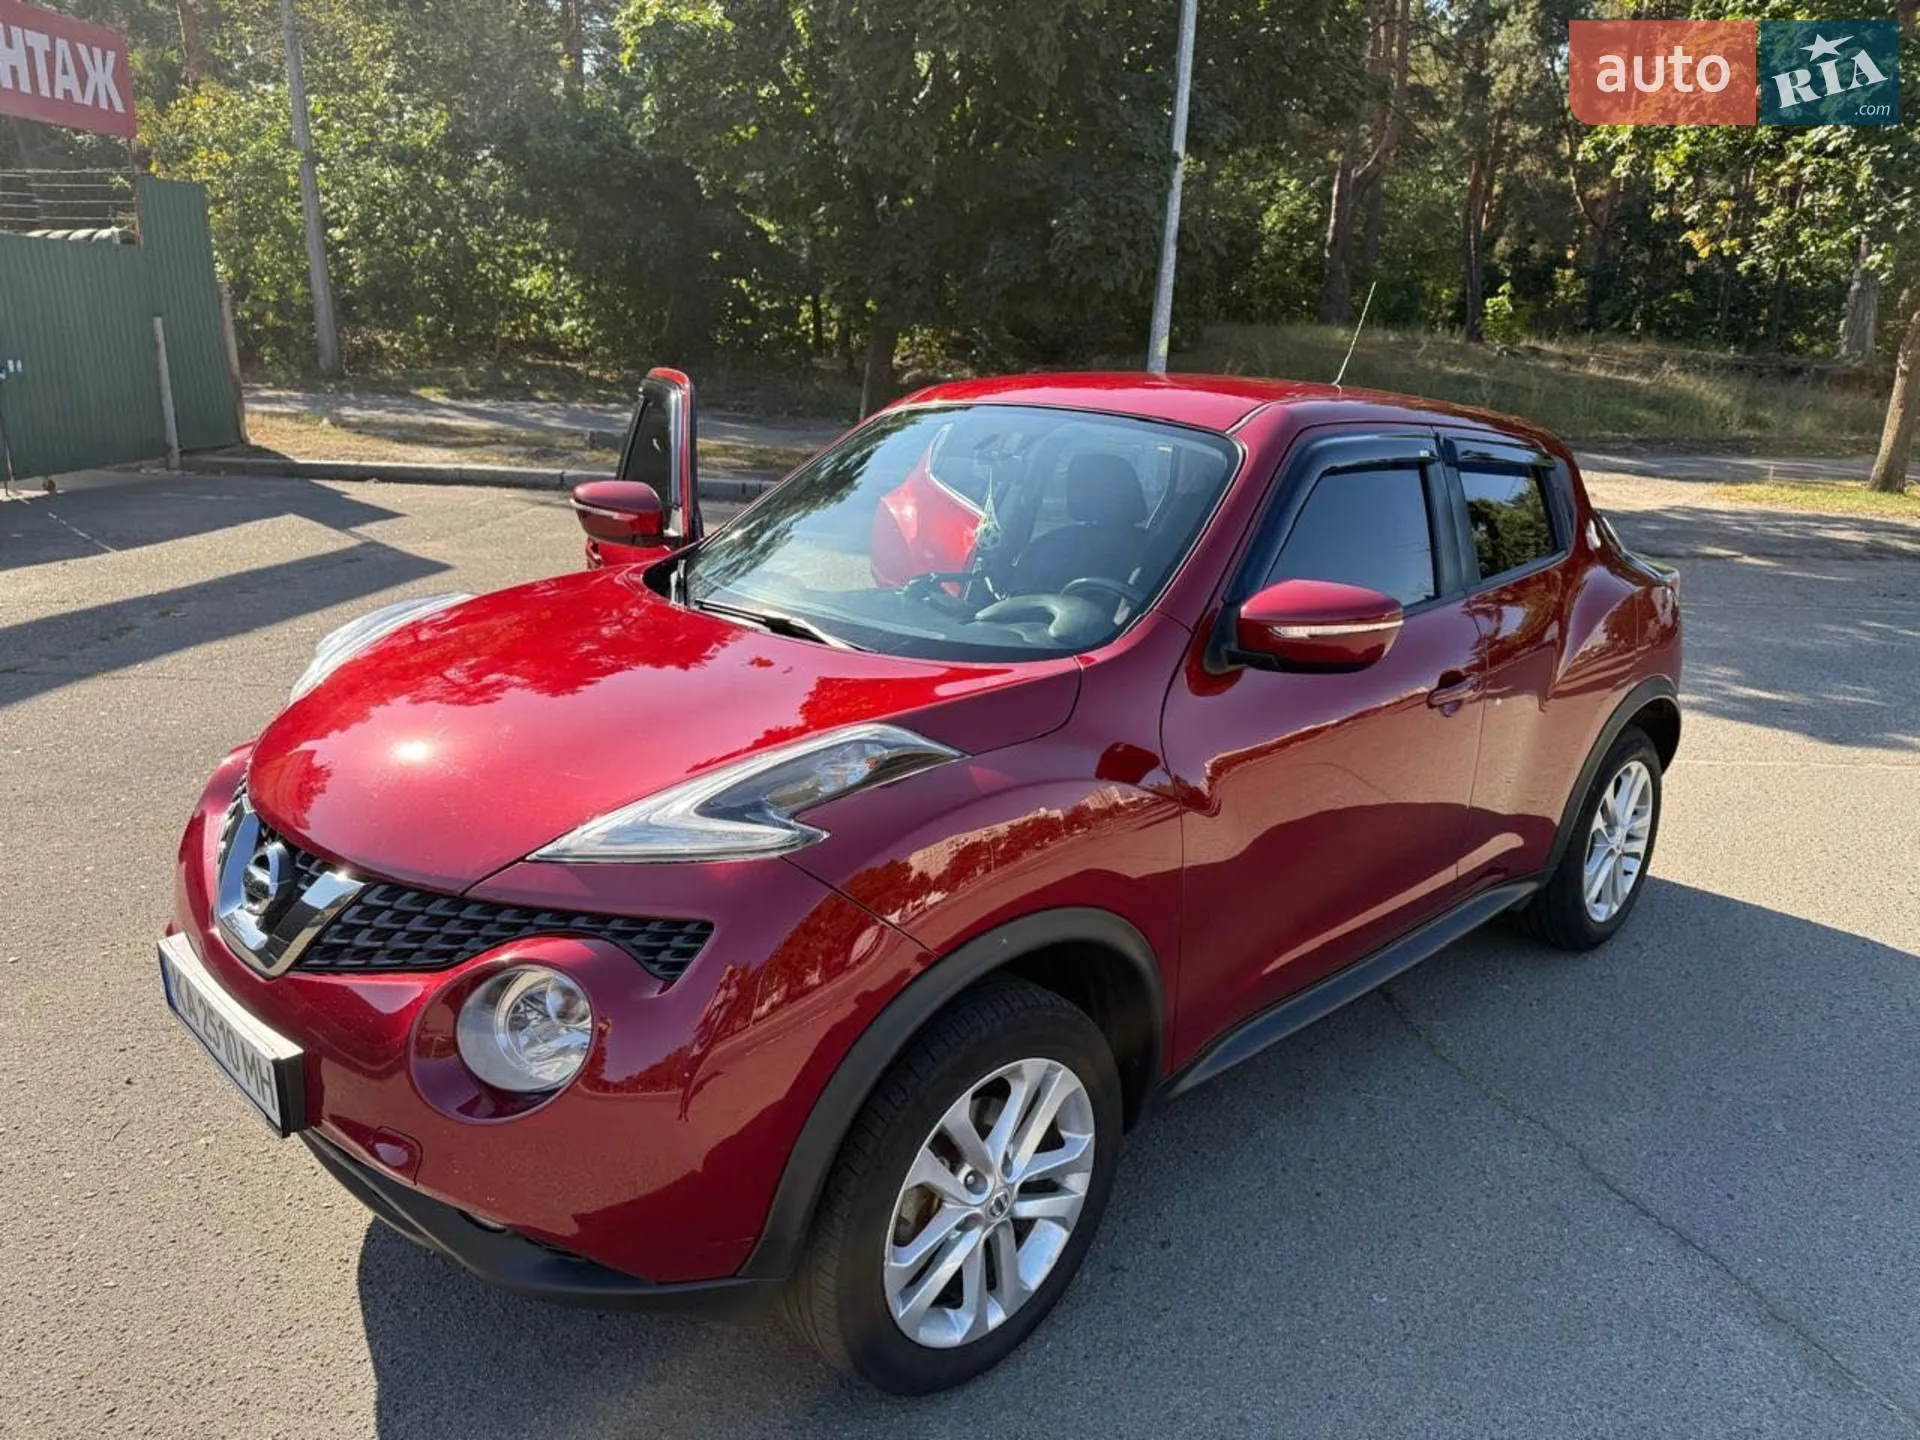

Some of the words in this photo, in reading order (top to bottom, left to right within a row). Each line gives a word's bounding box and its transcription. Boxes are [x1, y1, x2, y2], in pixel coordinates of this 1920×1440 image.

[0, 22, 126, 114] НТАЖ
[198, 996, 241, 1072] 2510
[240, 1040, 276, 1111] MH
